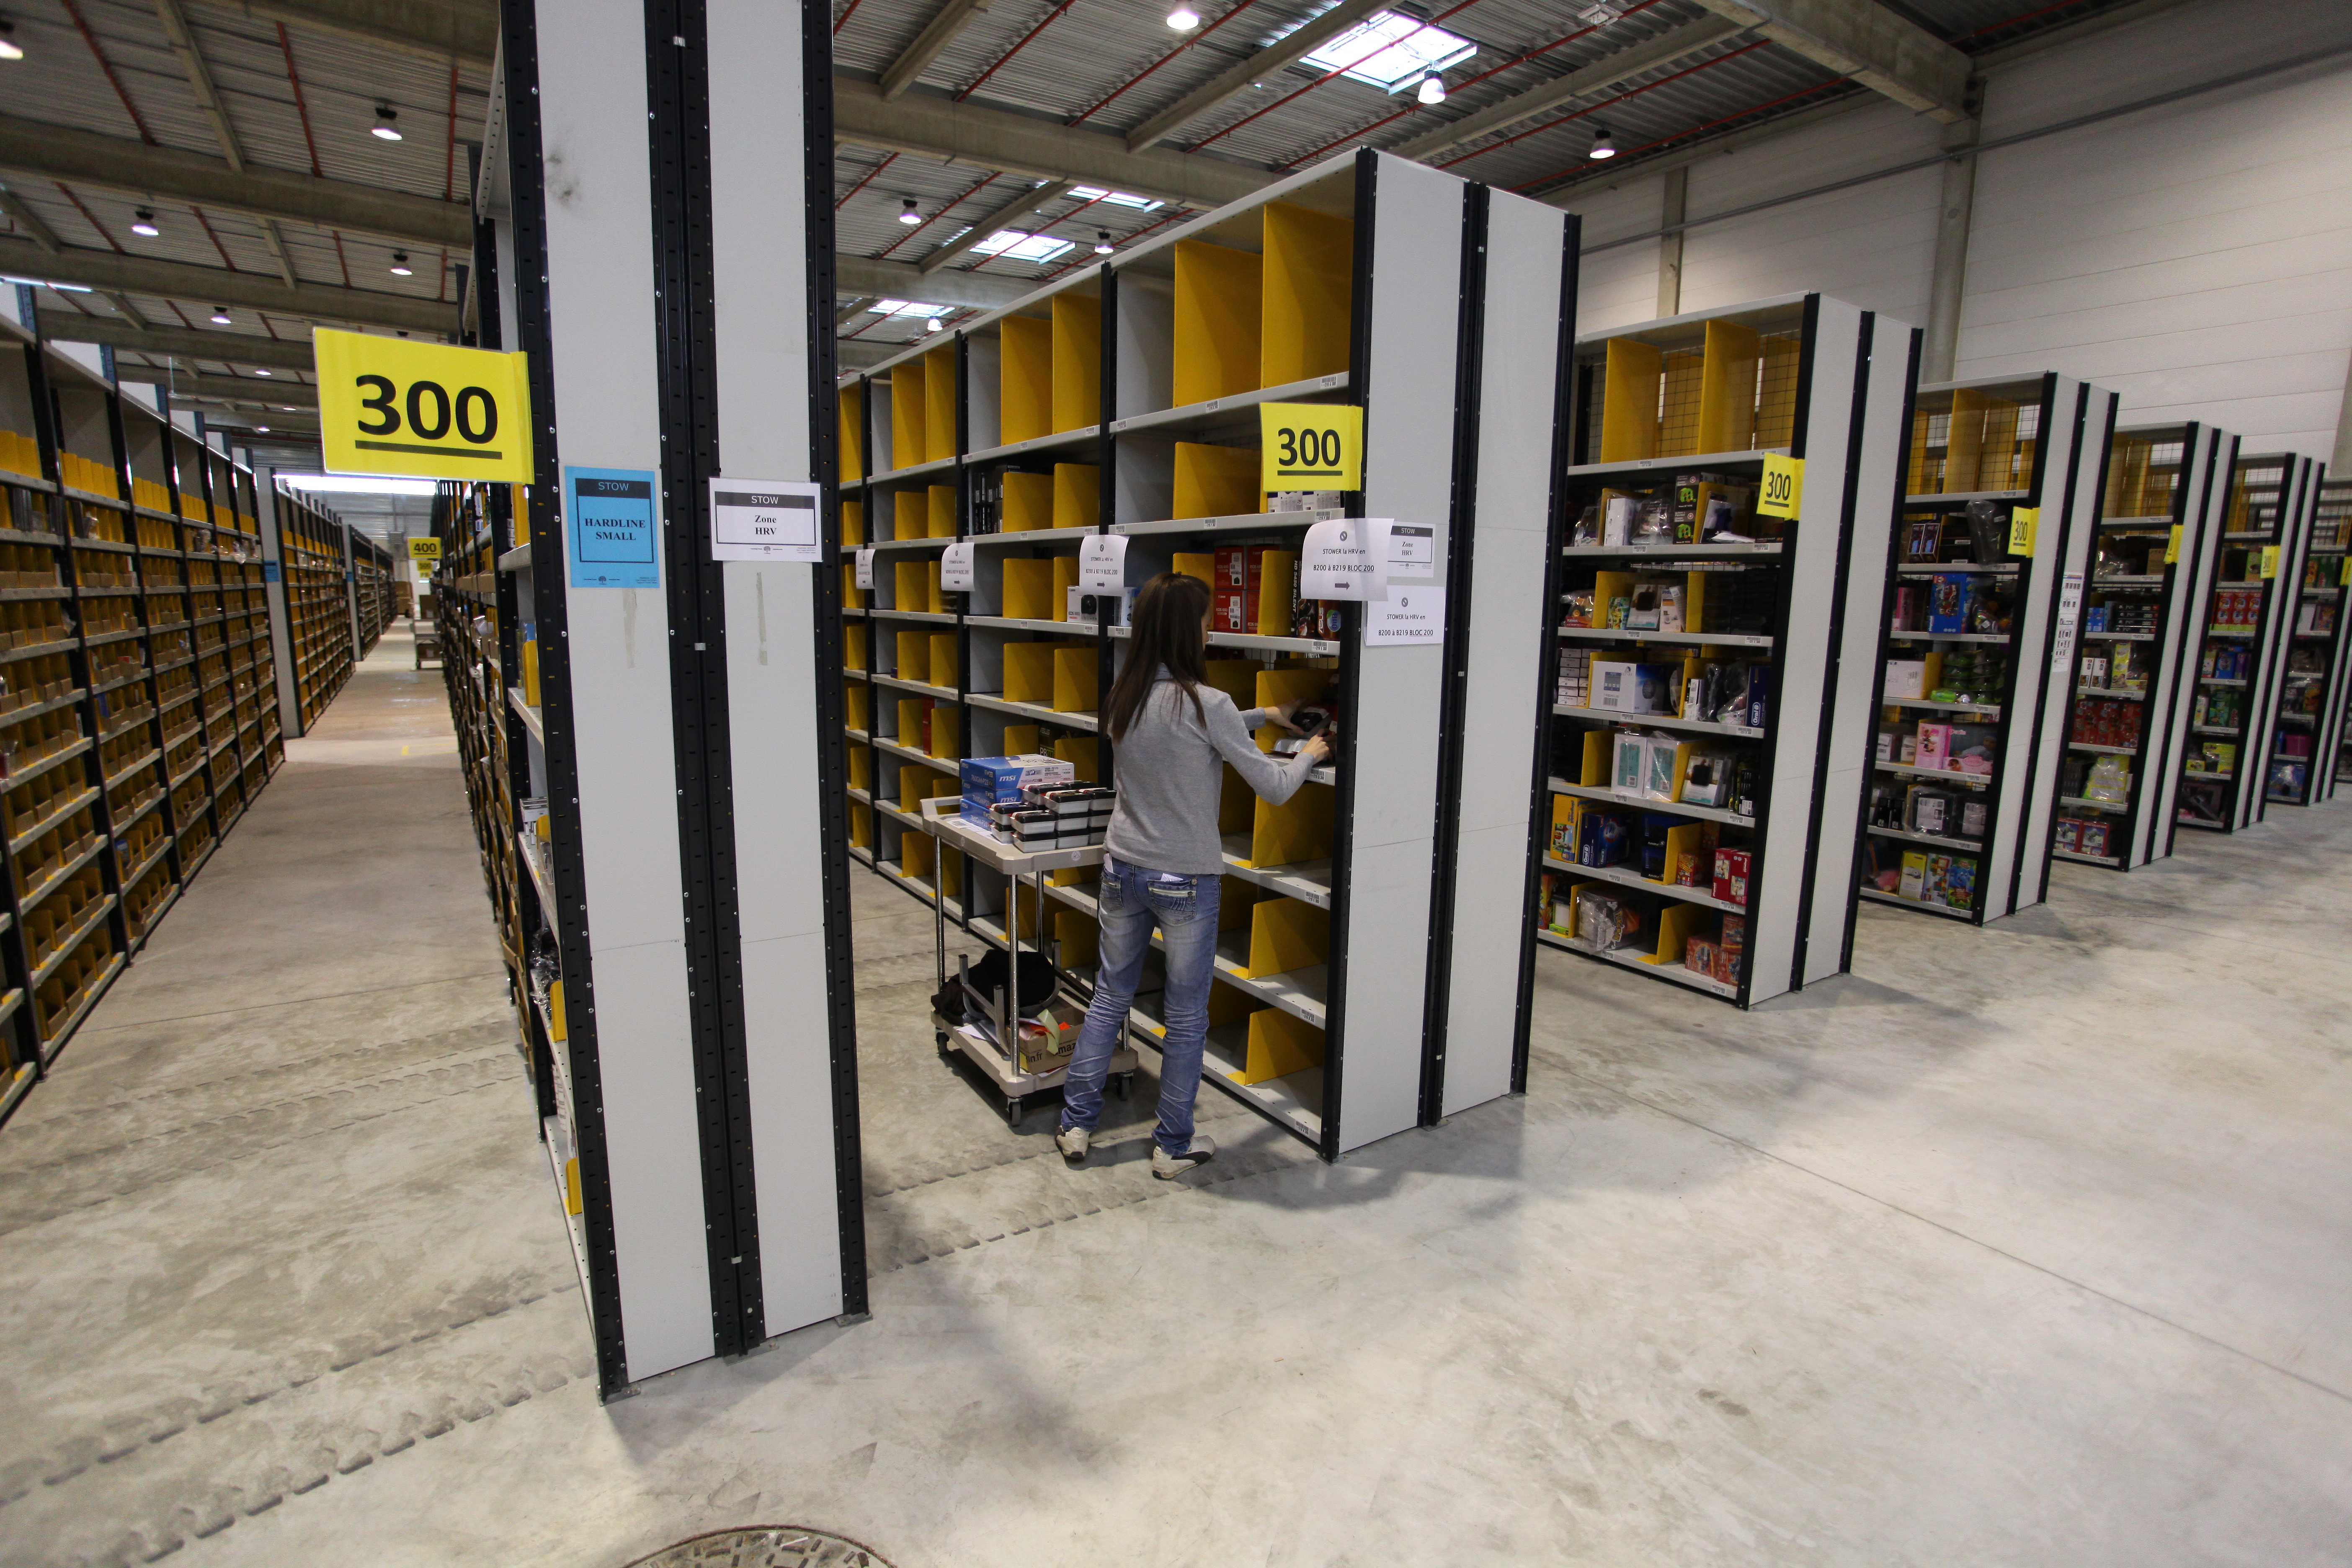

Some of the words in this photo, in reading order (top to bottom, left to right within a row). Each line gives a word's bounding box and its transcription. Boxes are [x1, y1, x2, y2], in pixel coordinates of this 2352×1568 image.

[356, 374, 498, 444] 300
[1278, 428, 1341, 467] 300
[598, 482, 629, 491] STOW
[1766, 471, 1791, 501] 300
[751, 495, 779, 504] STOW
[585, 518, 646, 528] HARDLINE
[596, 531, 636, 541] SMALL
[2014, 521, 2027, 542] 300
[414, 543, 437, 552] 400
[1294, 560, 1298, 570] HD
